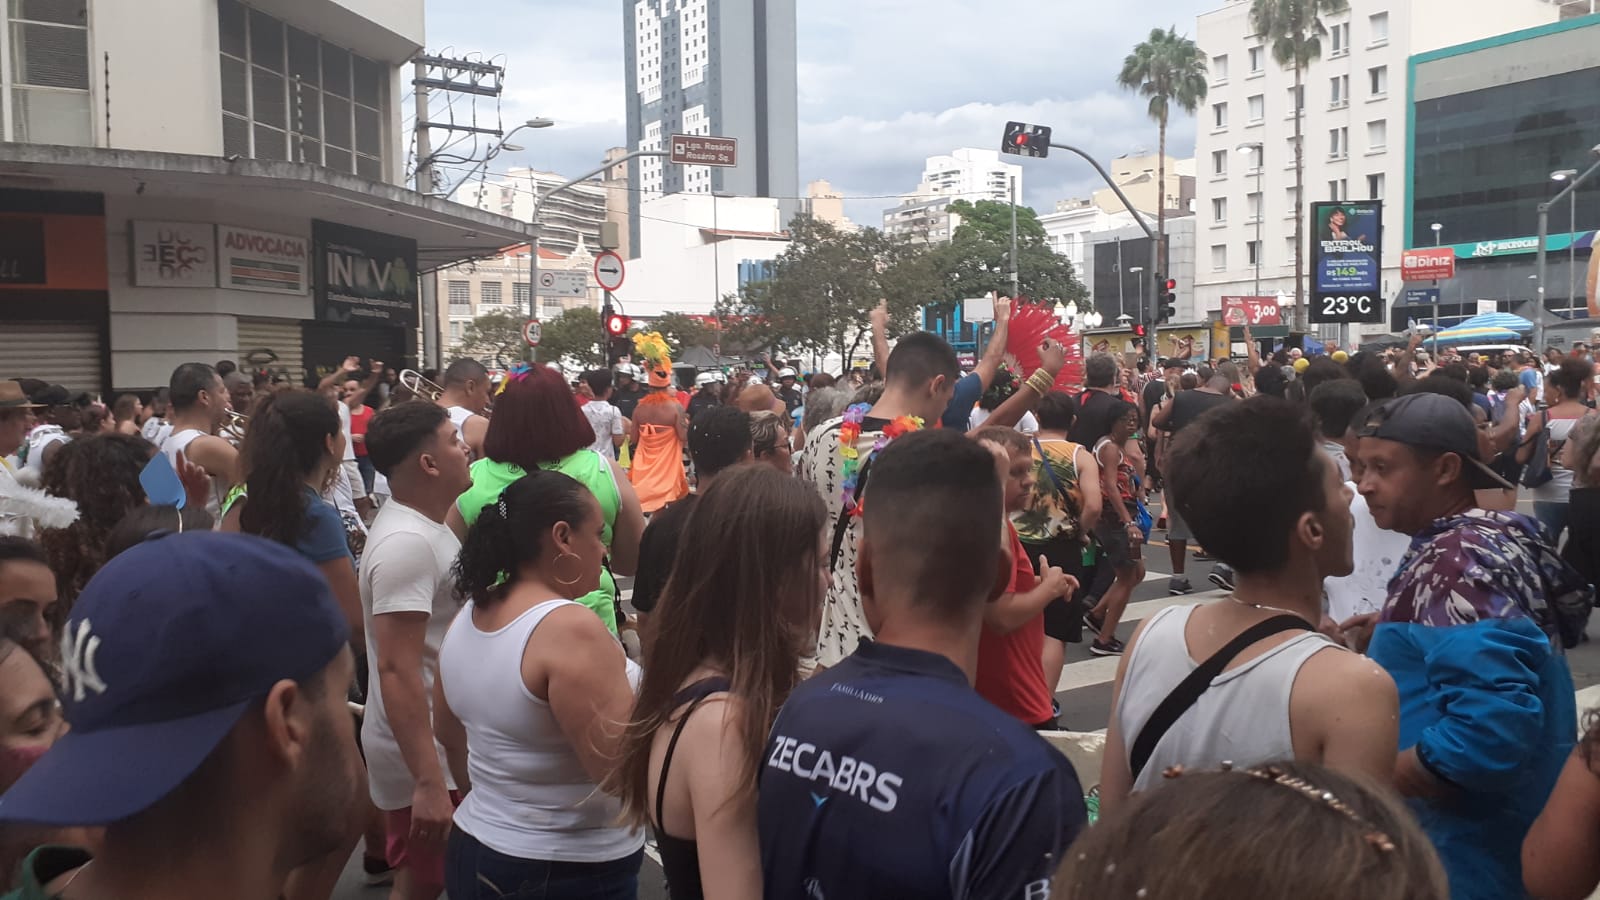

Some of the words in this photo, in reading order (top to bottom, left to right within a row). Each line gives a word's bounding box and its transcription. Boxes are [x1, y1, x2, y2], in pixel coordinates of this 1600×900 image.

[686, 152, 716, 160] Rosário
[705, 142, 734, 151] Rosário
[225, 232, 305, 258] ADVOCACIA
[1324, 245, 1374, 253] BRILHOU
[1252, 304, 1276, 324] 3,00
[1322, 296, 1372, 315] 23°C
[768, 735, 903, 813] ZECABRS
